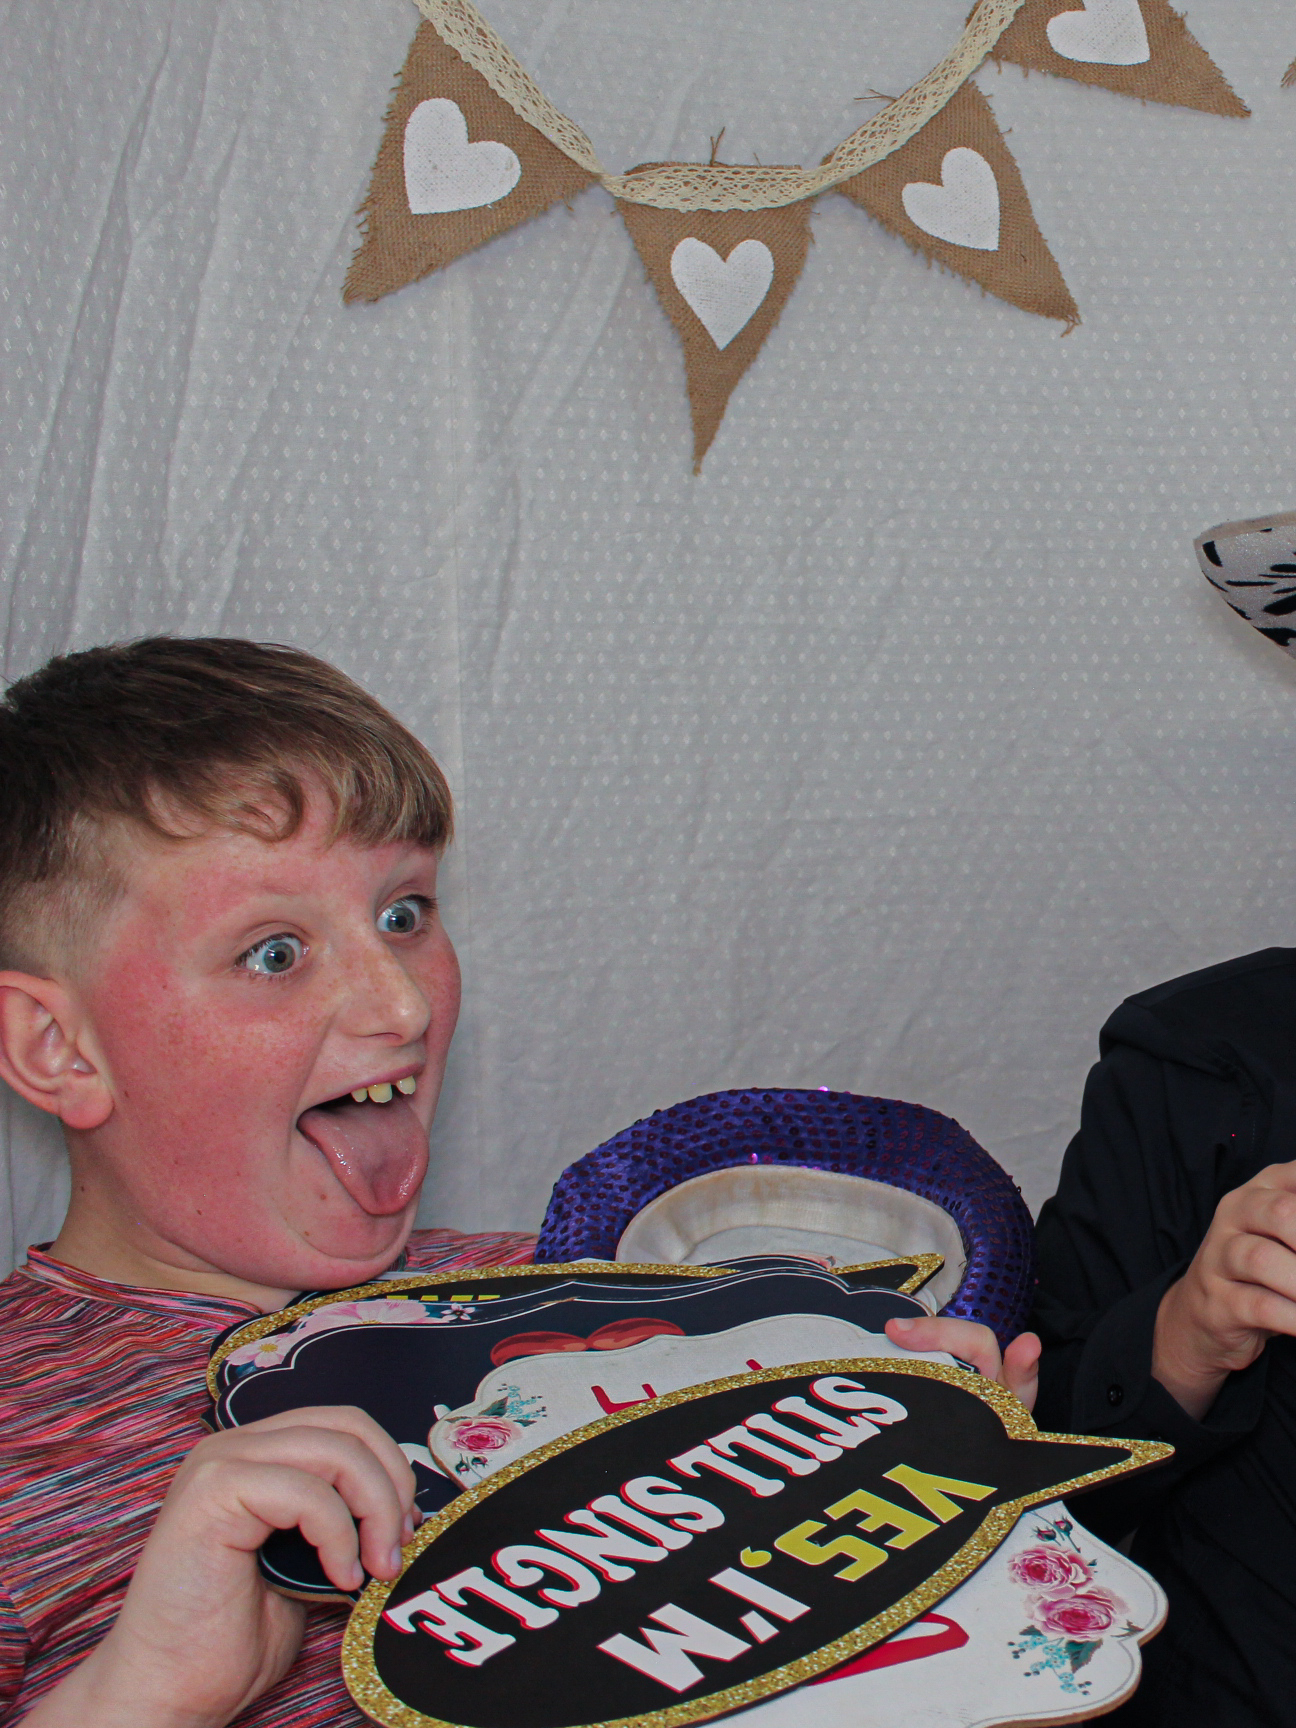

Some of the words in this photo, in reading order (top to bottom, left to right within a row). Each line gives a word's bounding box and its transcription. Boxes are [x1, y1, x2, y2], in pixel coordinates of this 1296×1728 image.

[666, 1376, 909, 1497] STILL
[381, 1475, 726, 1666] SINGLE
[738, 1462, 998, 1582] YES,
[597, 1566, 812, 1693] I'M
